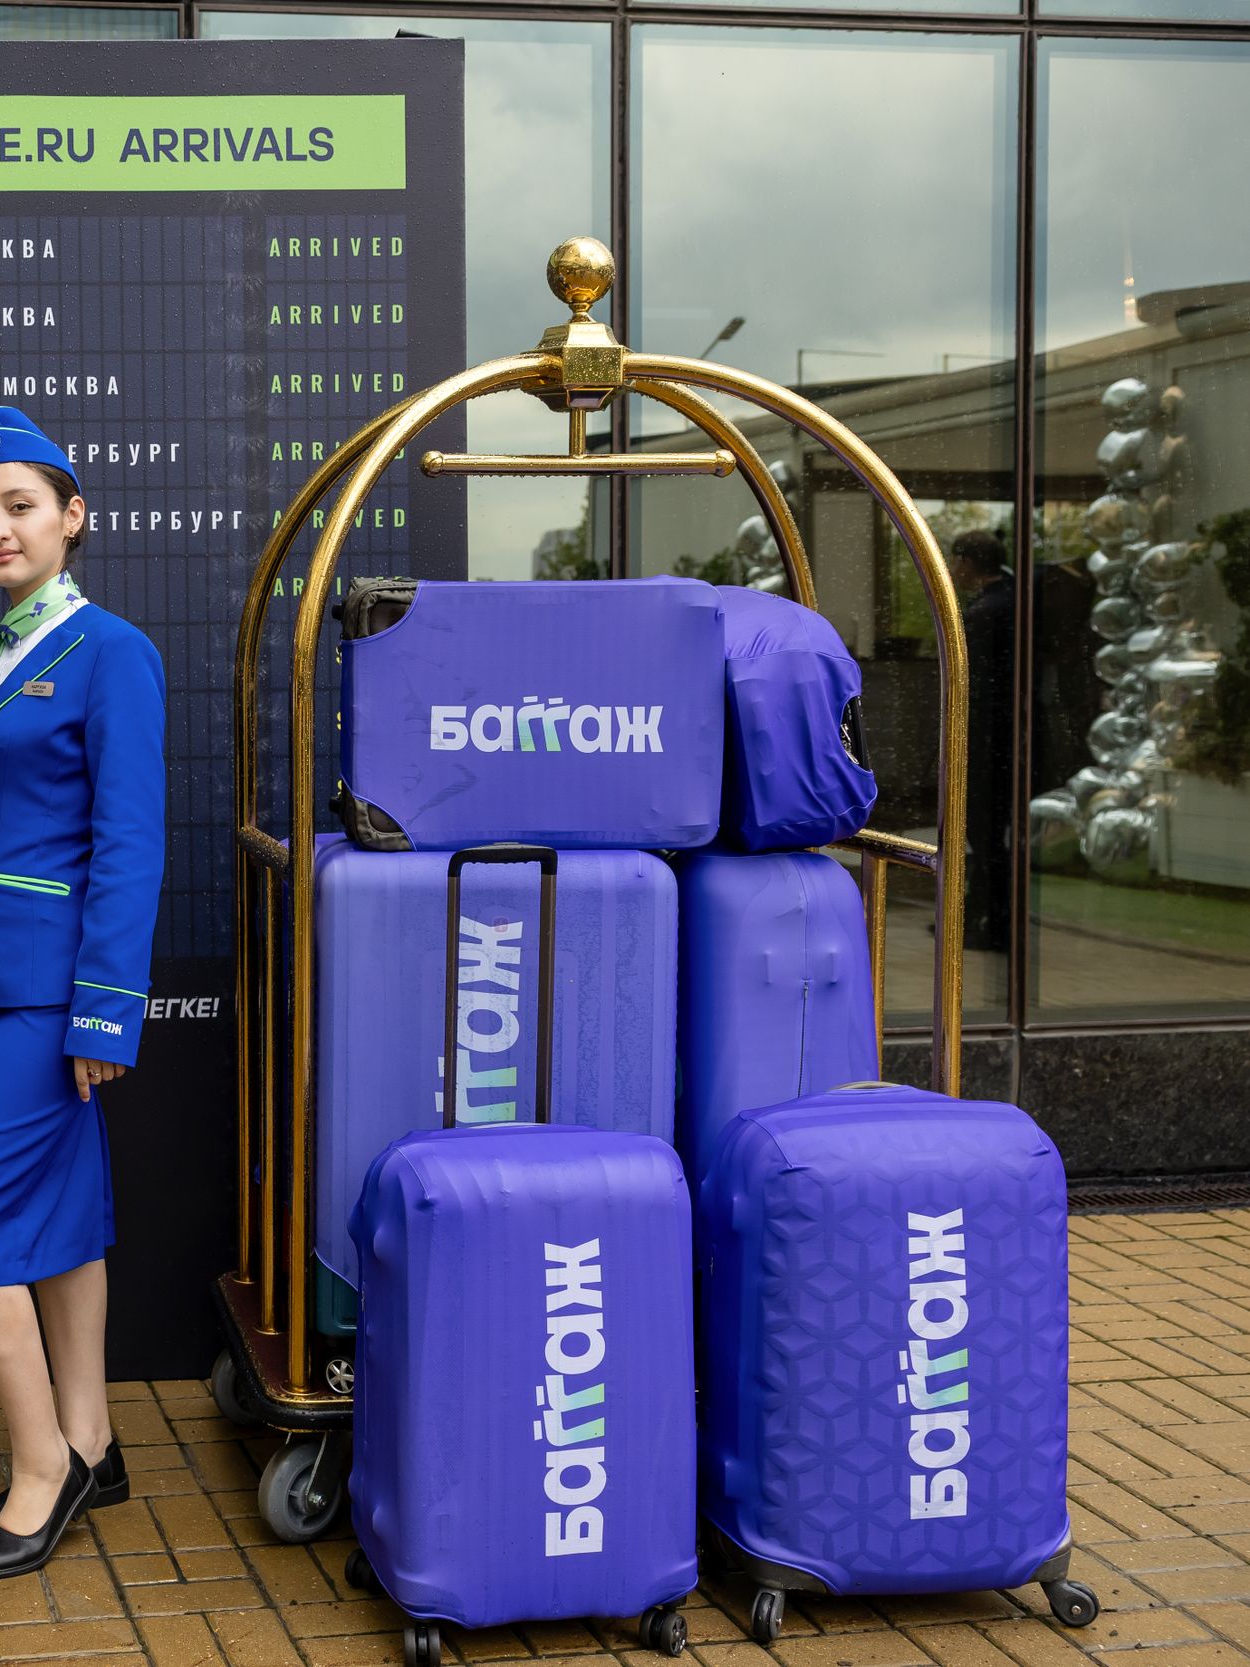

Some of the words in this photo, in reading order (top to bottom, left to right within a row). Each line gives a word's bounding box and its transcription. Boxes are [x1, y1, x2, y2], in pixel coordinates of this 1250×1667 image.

[120, 127, 333, 162] ARRIVALS
[270, 237, 402, 257] ARRIVED
[271, 305, 403, 324] ARRIVED
[272, 374, 403, 393] ARRIVED
